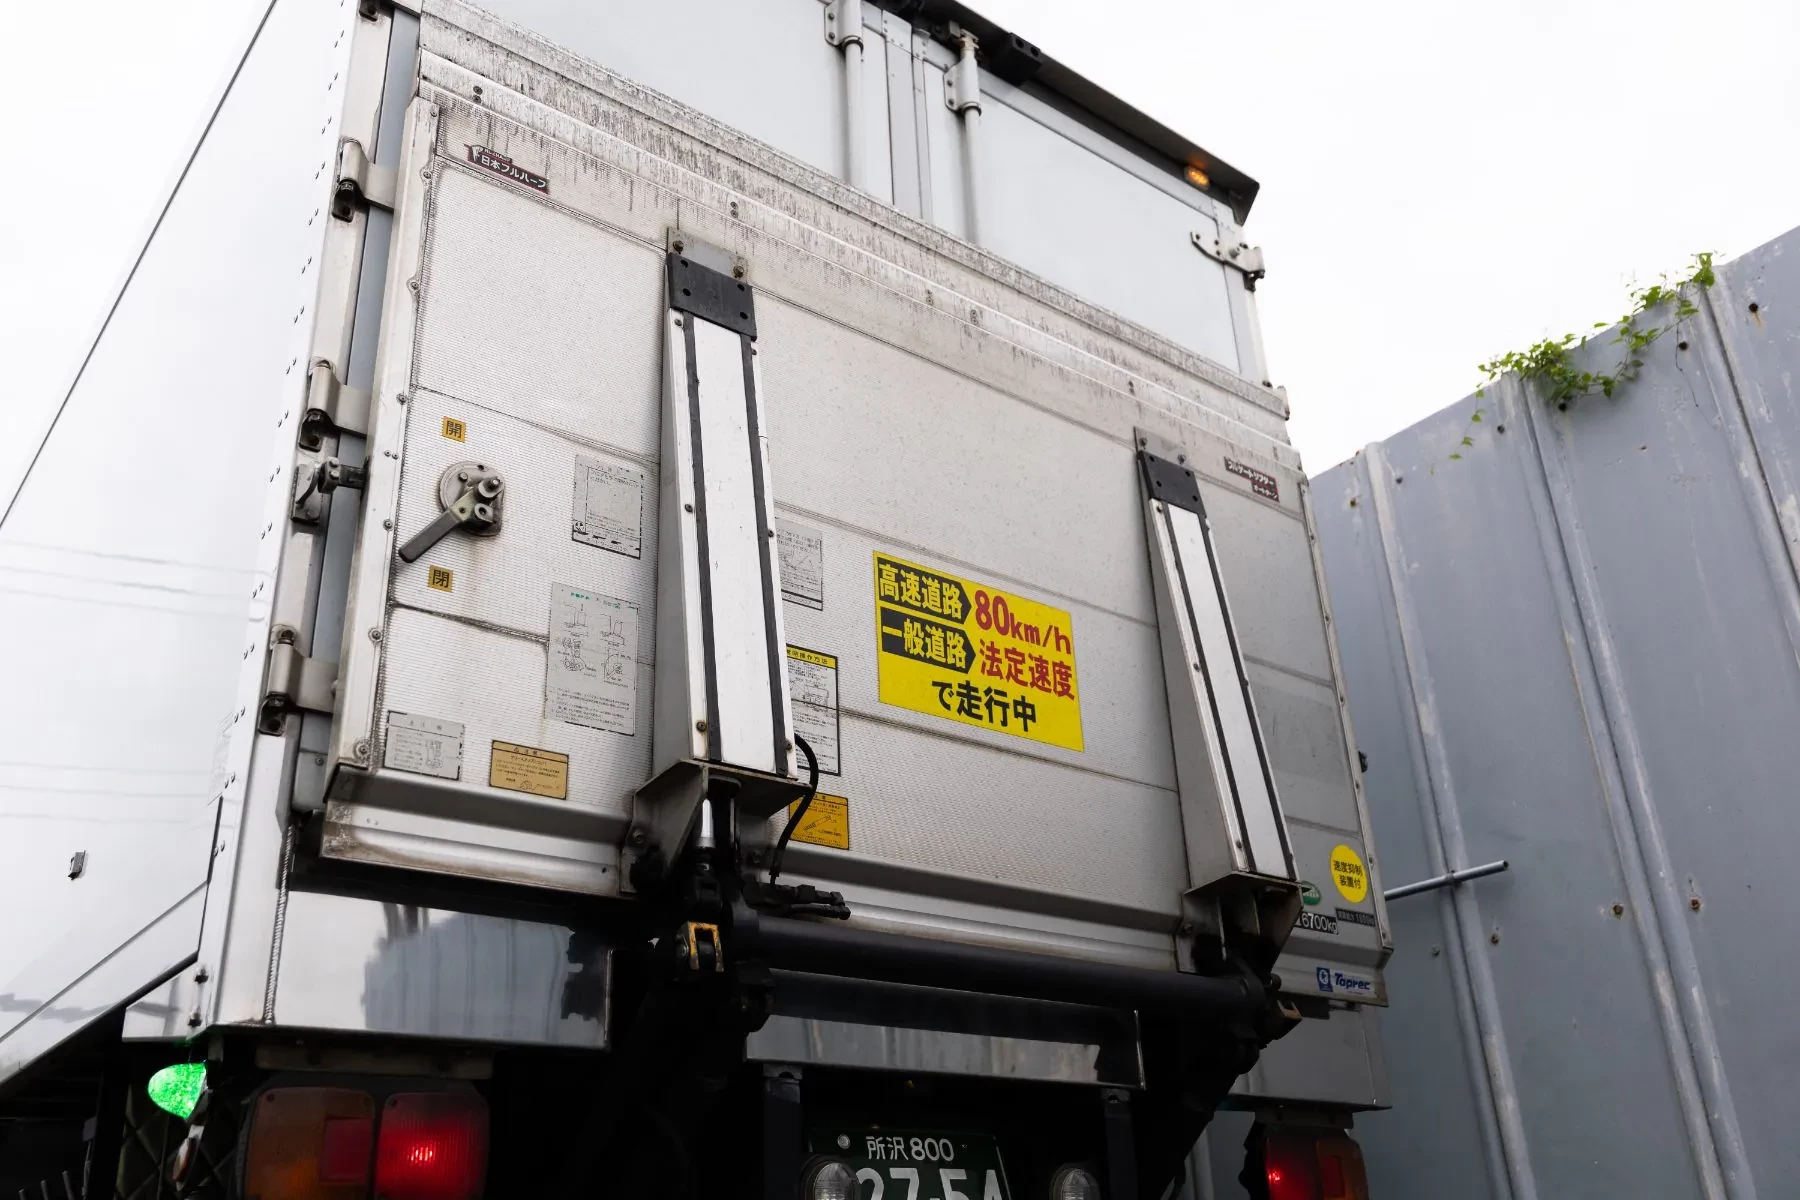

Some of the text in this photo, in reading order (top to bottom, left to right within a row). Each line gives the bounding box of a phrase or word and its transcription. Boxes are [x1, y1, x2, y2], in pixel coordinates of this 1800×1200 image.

[481, 155, 546, 188] 日本フルハーフ
[446, 420, 462, 438] 開
[432, 569, 450, 588] 閉
[879, 563, 963, 618] 高速道路
[975, 590, 1071, 655] 80km/h
[882, 618, 1075, 700] 一般道路 法定速度
[931, 680, 1036, 732] で走行中
[1332, 860, 1363, 877] 速度抑制
[1339, 874, 1362, 889] 装置付
